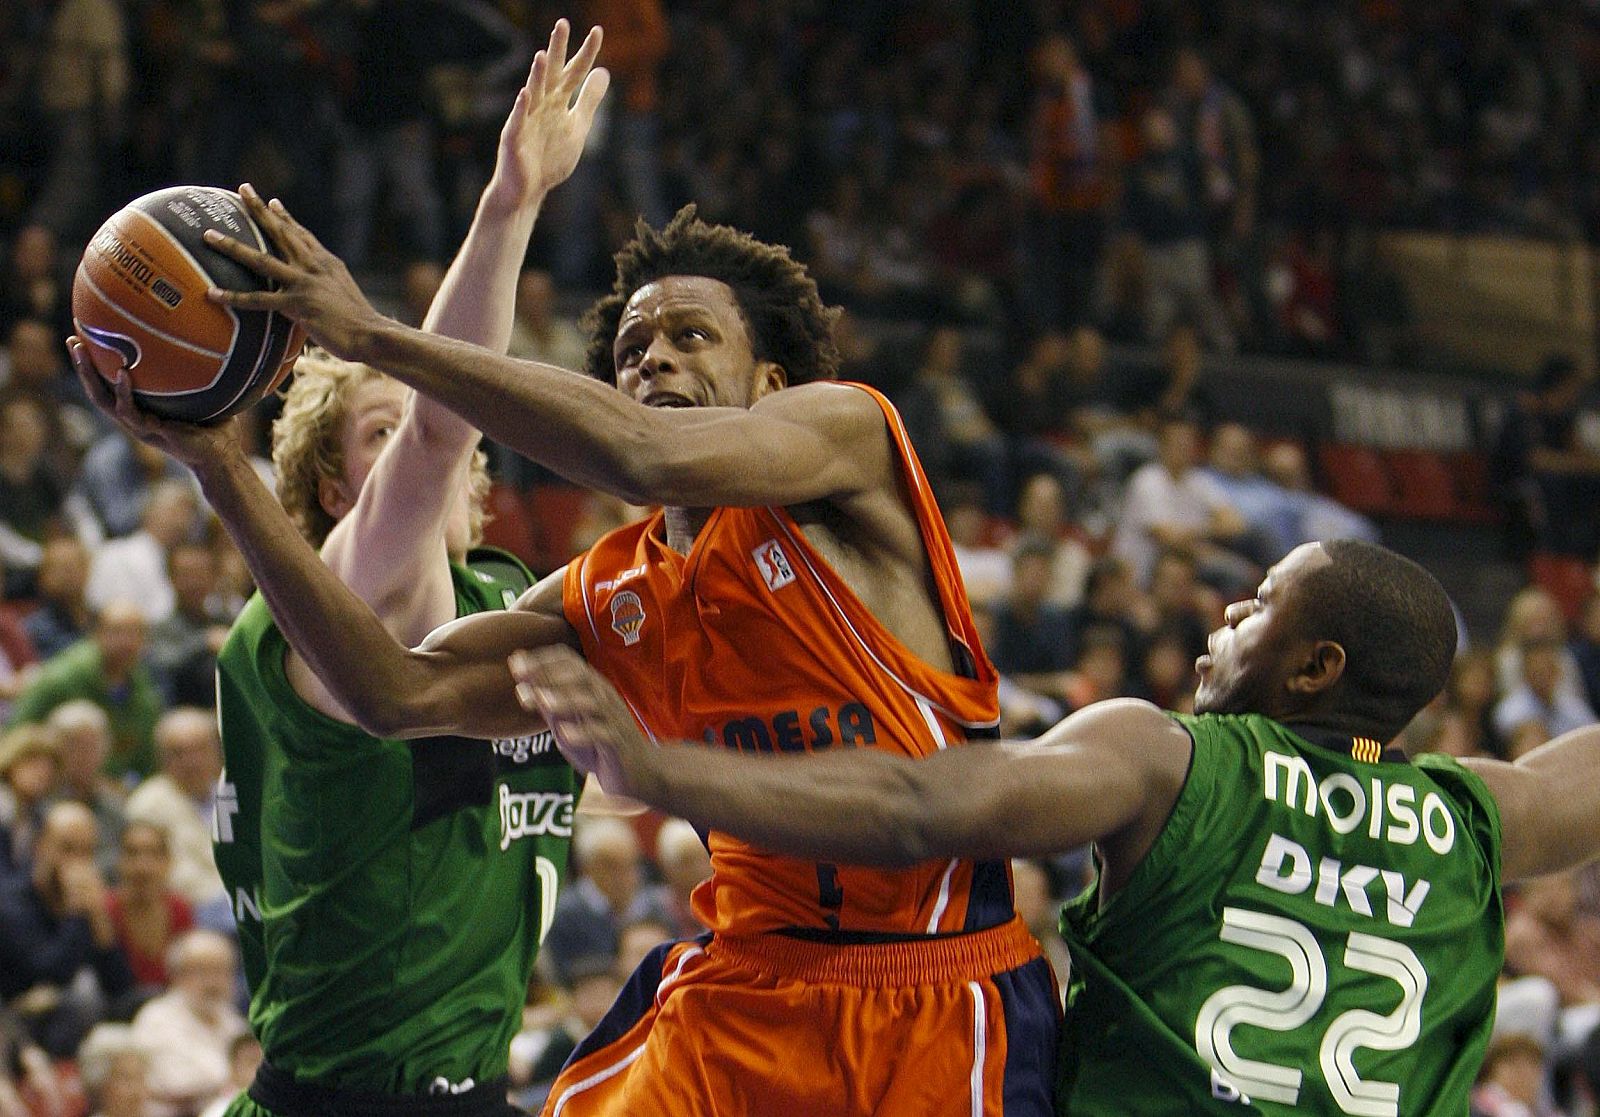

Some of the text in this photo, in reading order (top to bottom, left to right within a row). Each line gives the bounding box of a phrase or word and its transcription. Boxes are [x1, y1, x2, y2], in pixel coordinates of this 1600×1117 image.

[1264, 750, 1455, 855] MOISO
[1255, 832, 1431, 928] DKV
[1195, 906, 1429, 1117] 22
